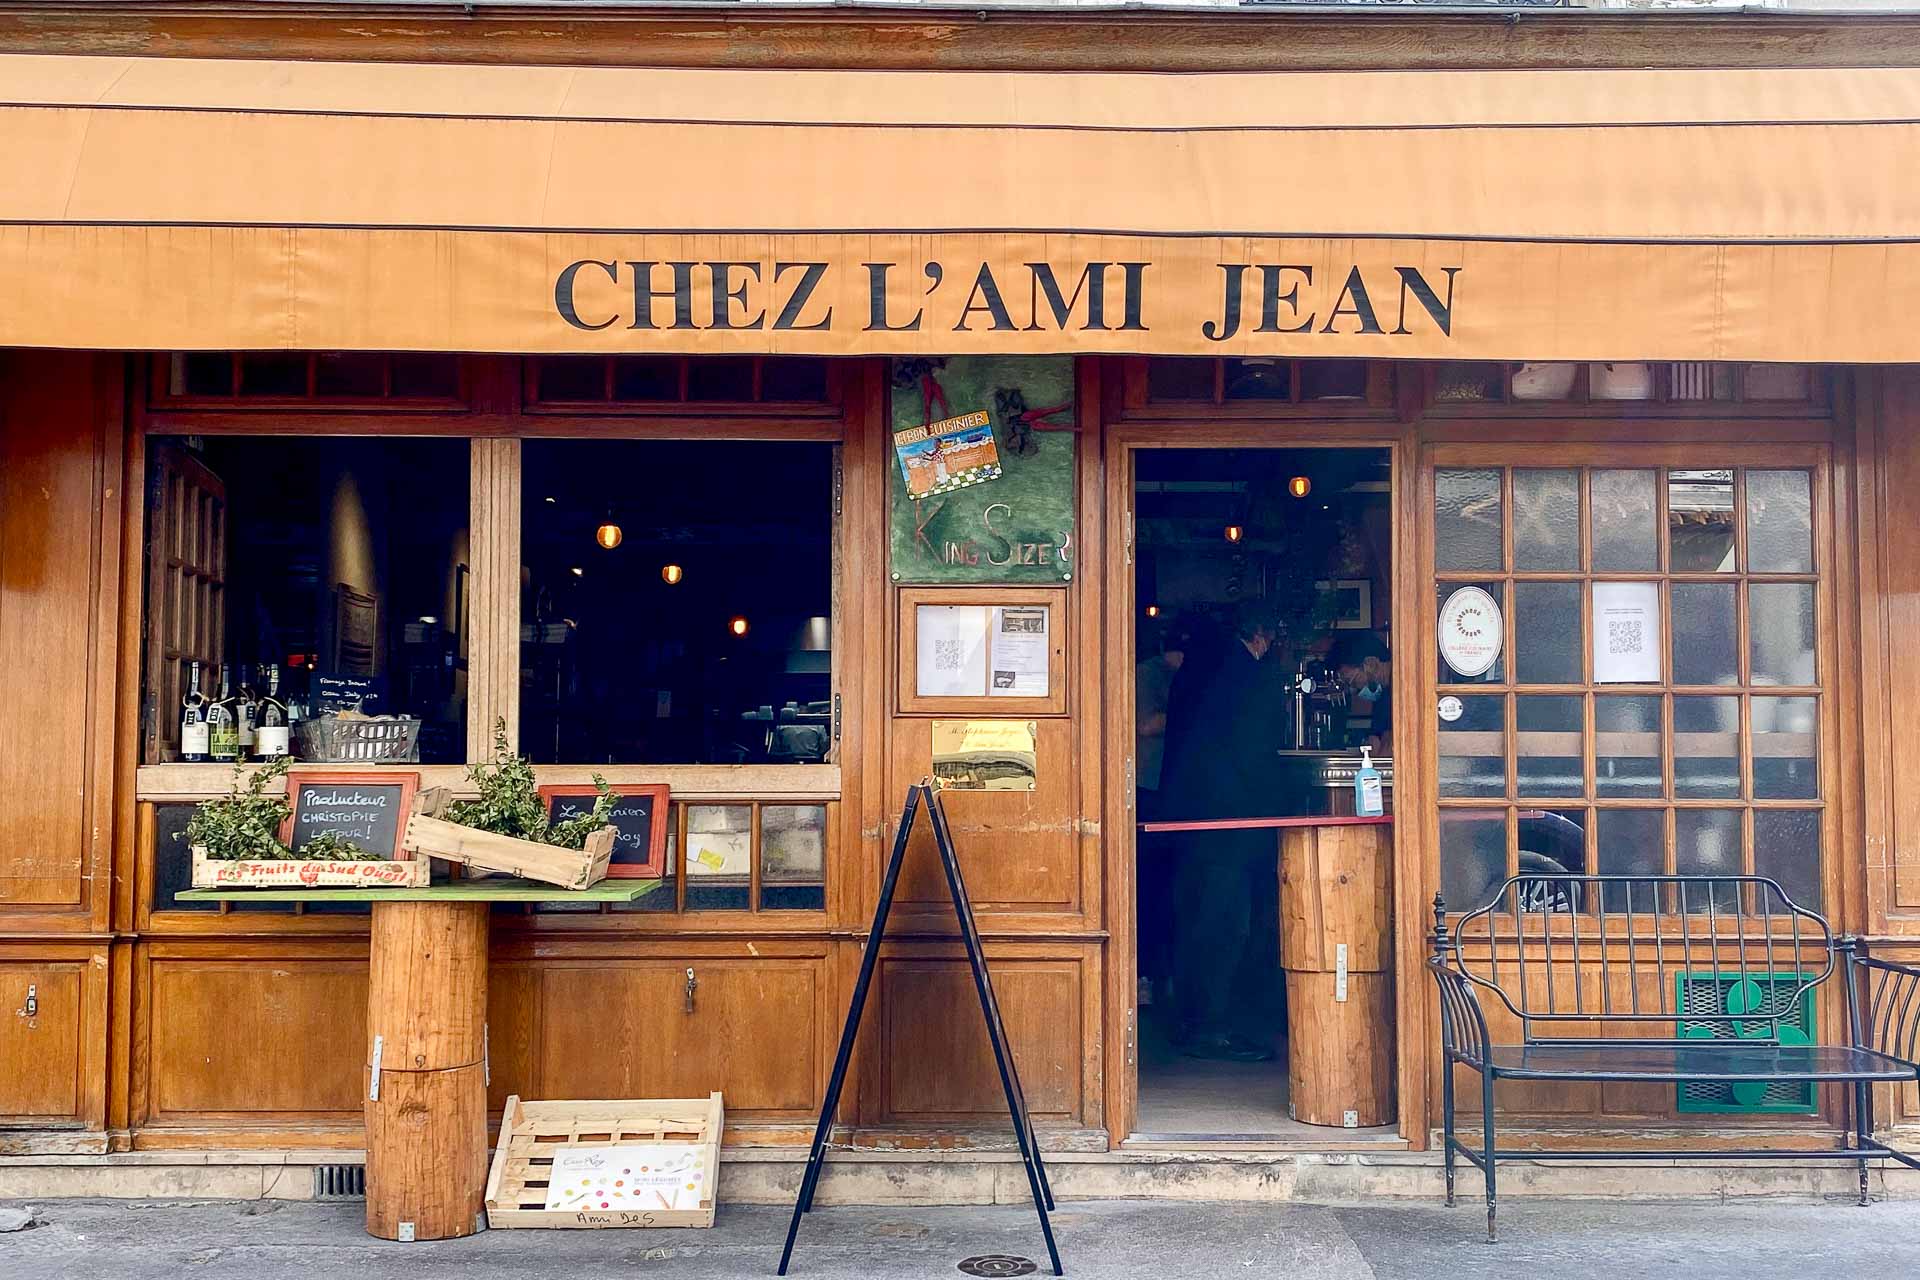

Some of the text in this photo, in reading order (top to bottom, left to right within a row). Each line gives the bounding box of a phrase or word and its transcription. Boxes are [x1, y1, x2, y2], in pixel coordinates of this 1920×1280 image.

[554, 259, 833, 331] CHEZ
[1201, 262, 1463, 342] JEAN
[303, 789, 387, 807] Producteur
[251, 862, 295, 877] Fruits
[301, 861, 321, 873] du
[327, 862, 359, 875] Sud
